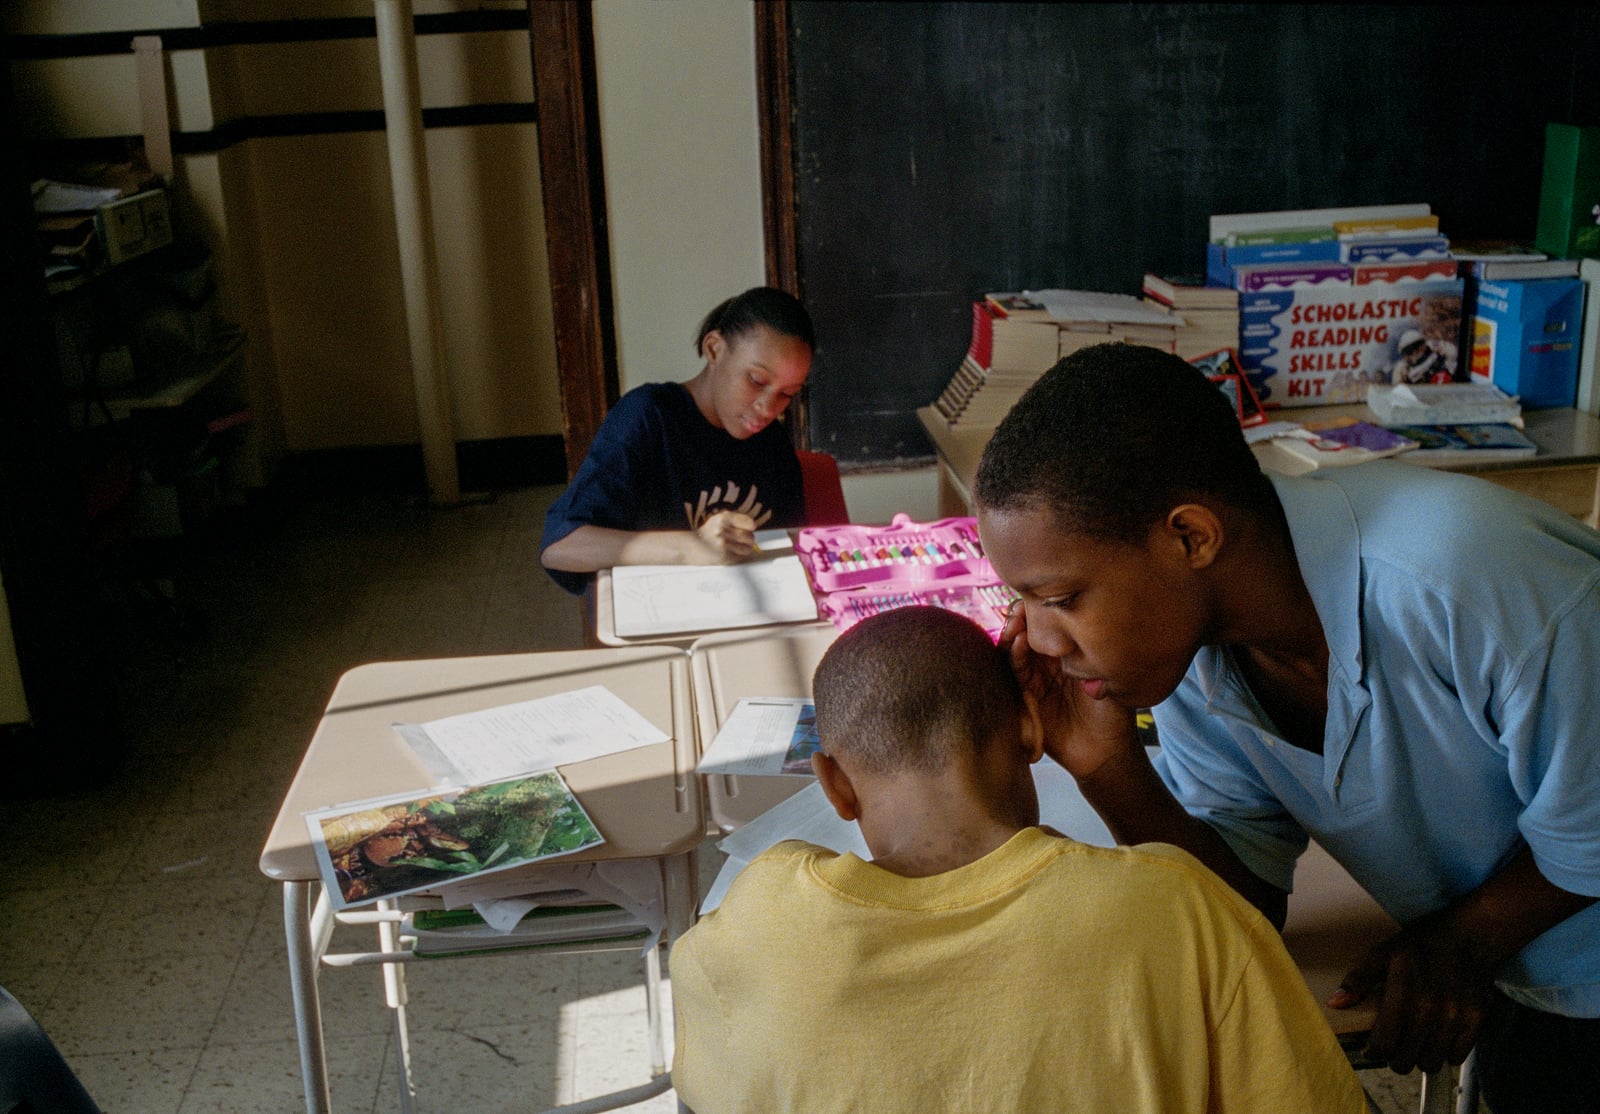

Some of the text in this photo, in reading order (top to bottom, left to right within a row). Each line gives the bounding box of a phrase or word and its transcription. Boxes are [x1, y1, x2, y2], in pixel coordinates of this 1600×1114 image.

[1291, 297, 1421, 325] SCHOLASTIC
[1290, 325, 1389, 348] READING
[1289, 351, 1361, 373] SKILLS
[1288, 378, 1326, 398] KIT
